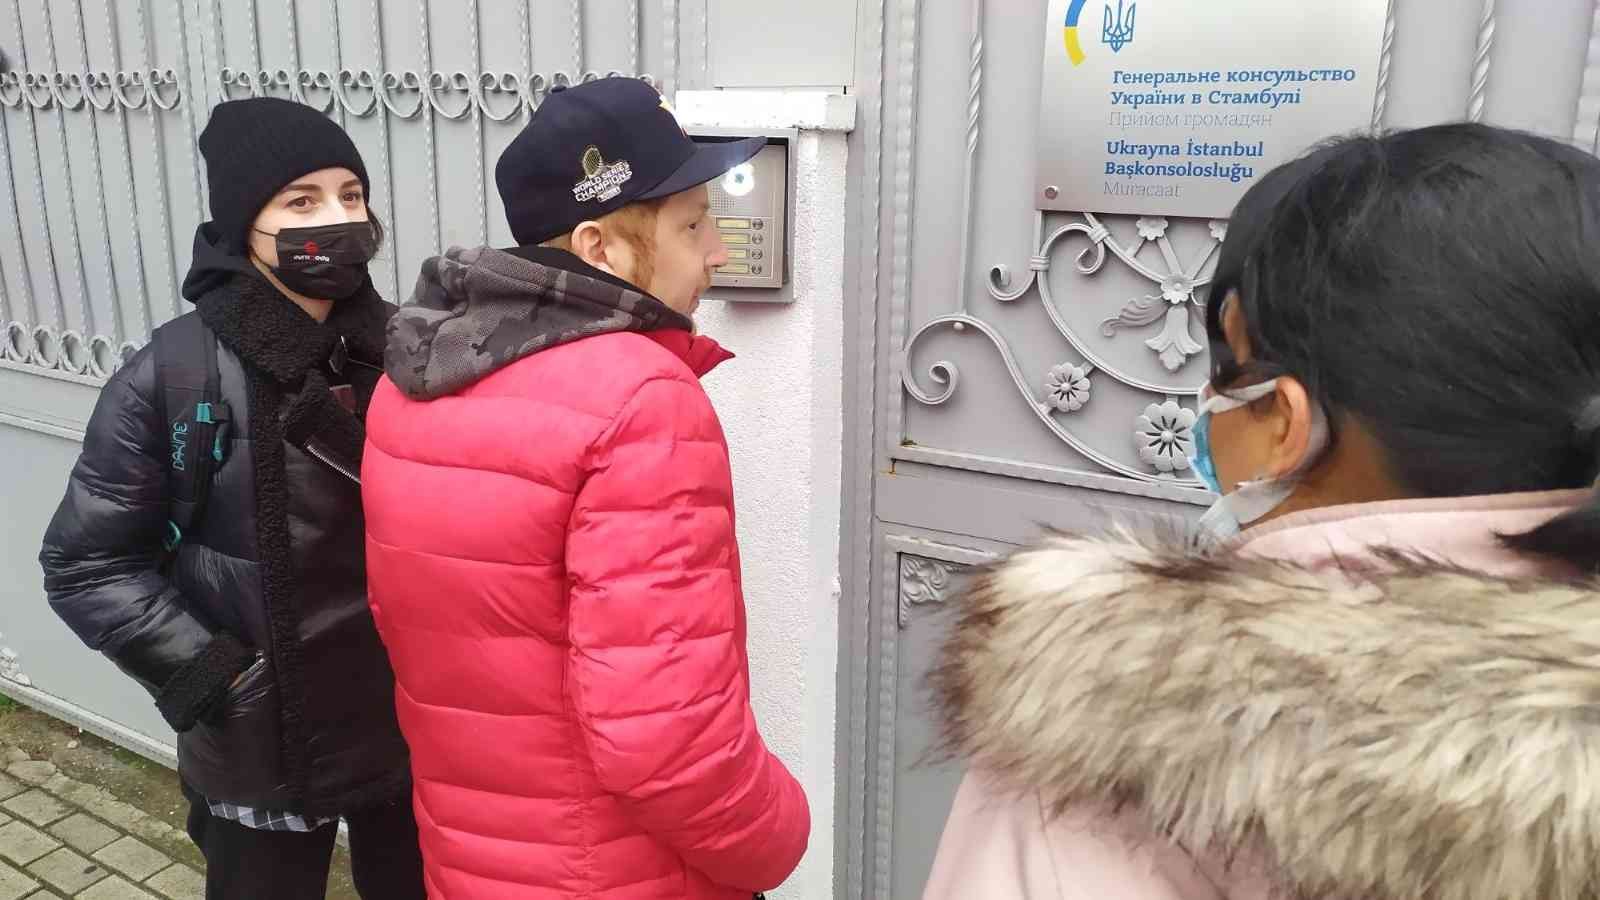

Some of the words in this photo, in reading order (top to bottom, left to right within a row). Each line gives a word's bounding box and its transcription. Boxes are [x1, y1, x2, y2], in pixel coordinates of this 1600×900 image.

[1113, 70, 1221, 87] Генеральне
[1226, 69, 1356, 87] консульство
[1111, 90, 1186, 109] України
[1191, 92, 1203, 105] в
[1208, 88, 1302, 109] Стамбулі
[1109, 111, 1179, 129] Прийом
[1184, 113, 1273, 130] громадян
[1106, 141, 1180, 160] Ukrayna
[1187, 138, 1264, 157] İstanbul
[572, 176, 602, 194] WORLD
[602, 161, 630, 180] SERIES
[1104, 161, 1253, 182] Başkonsolosluğu
[575, 171, 632, 201] CHAMPIONS
[1103, 181, 1181, 198] Muracaat
